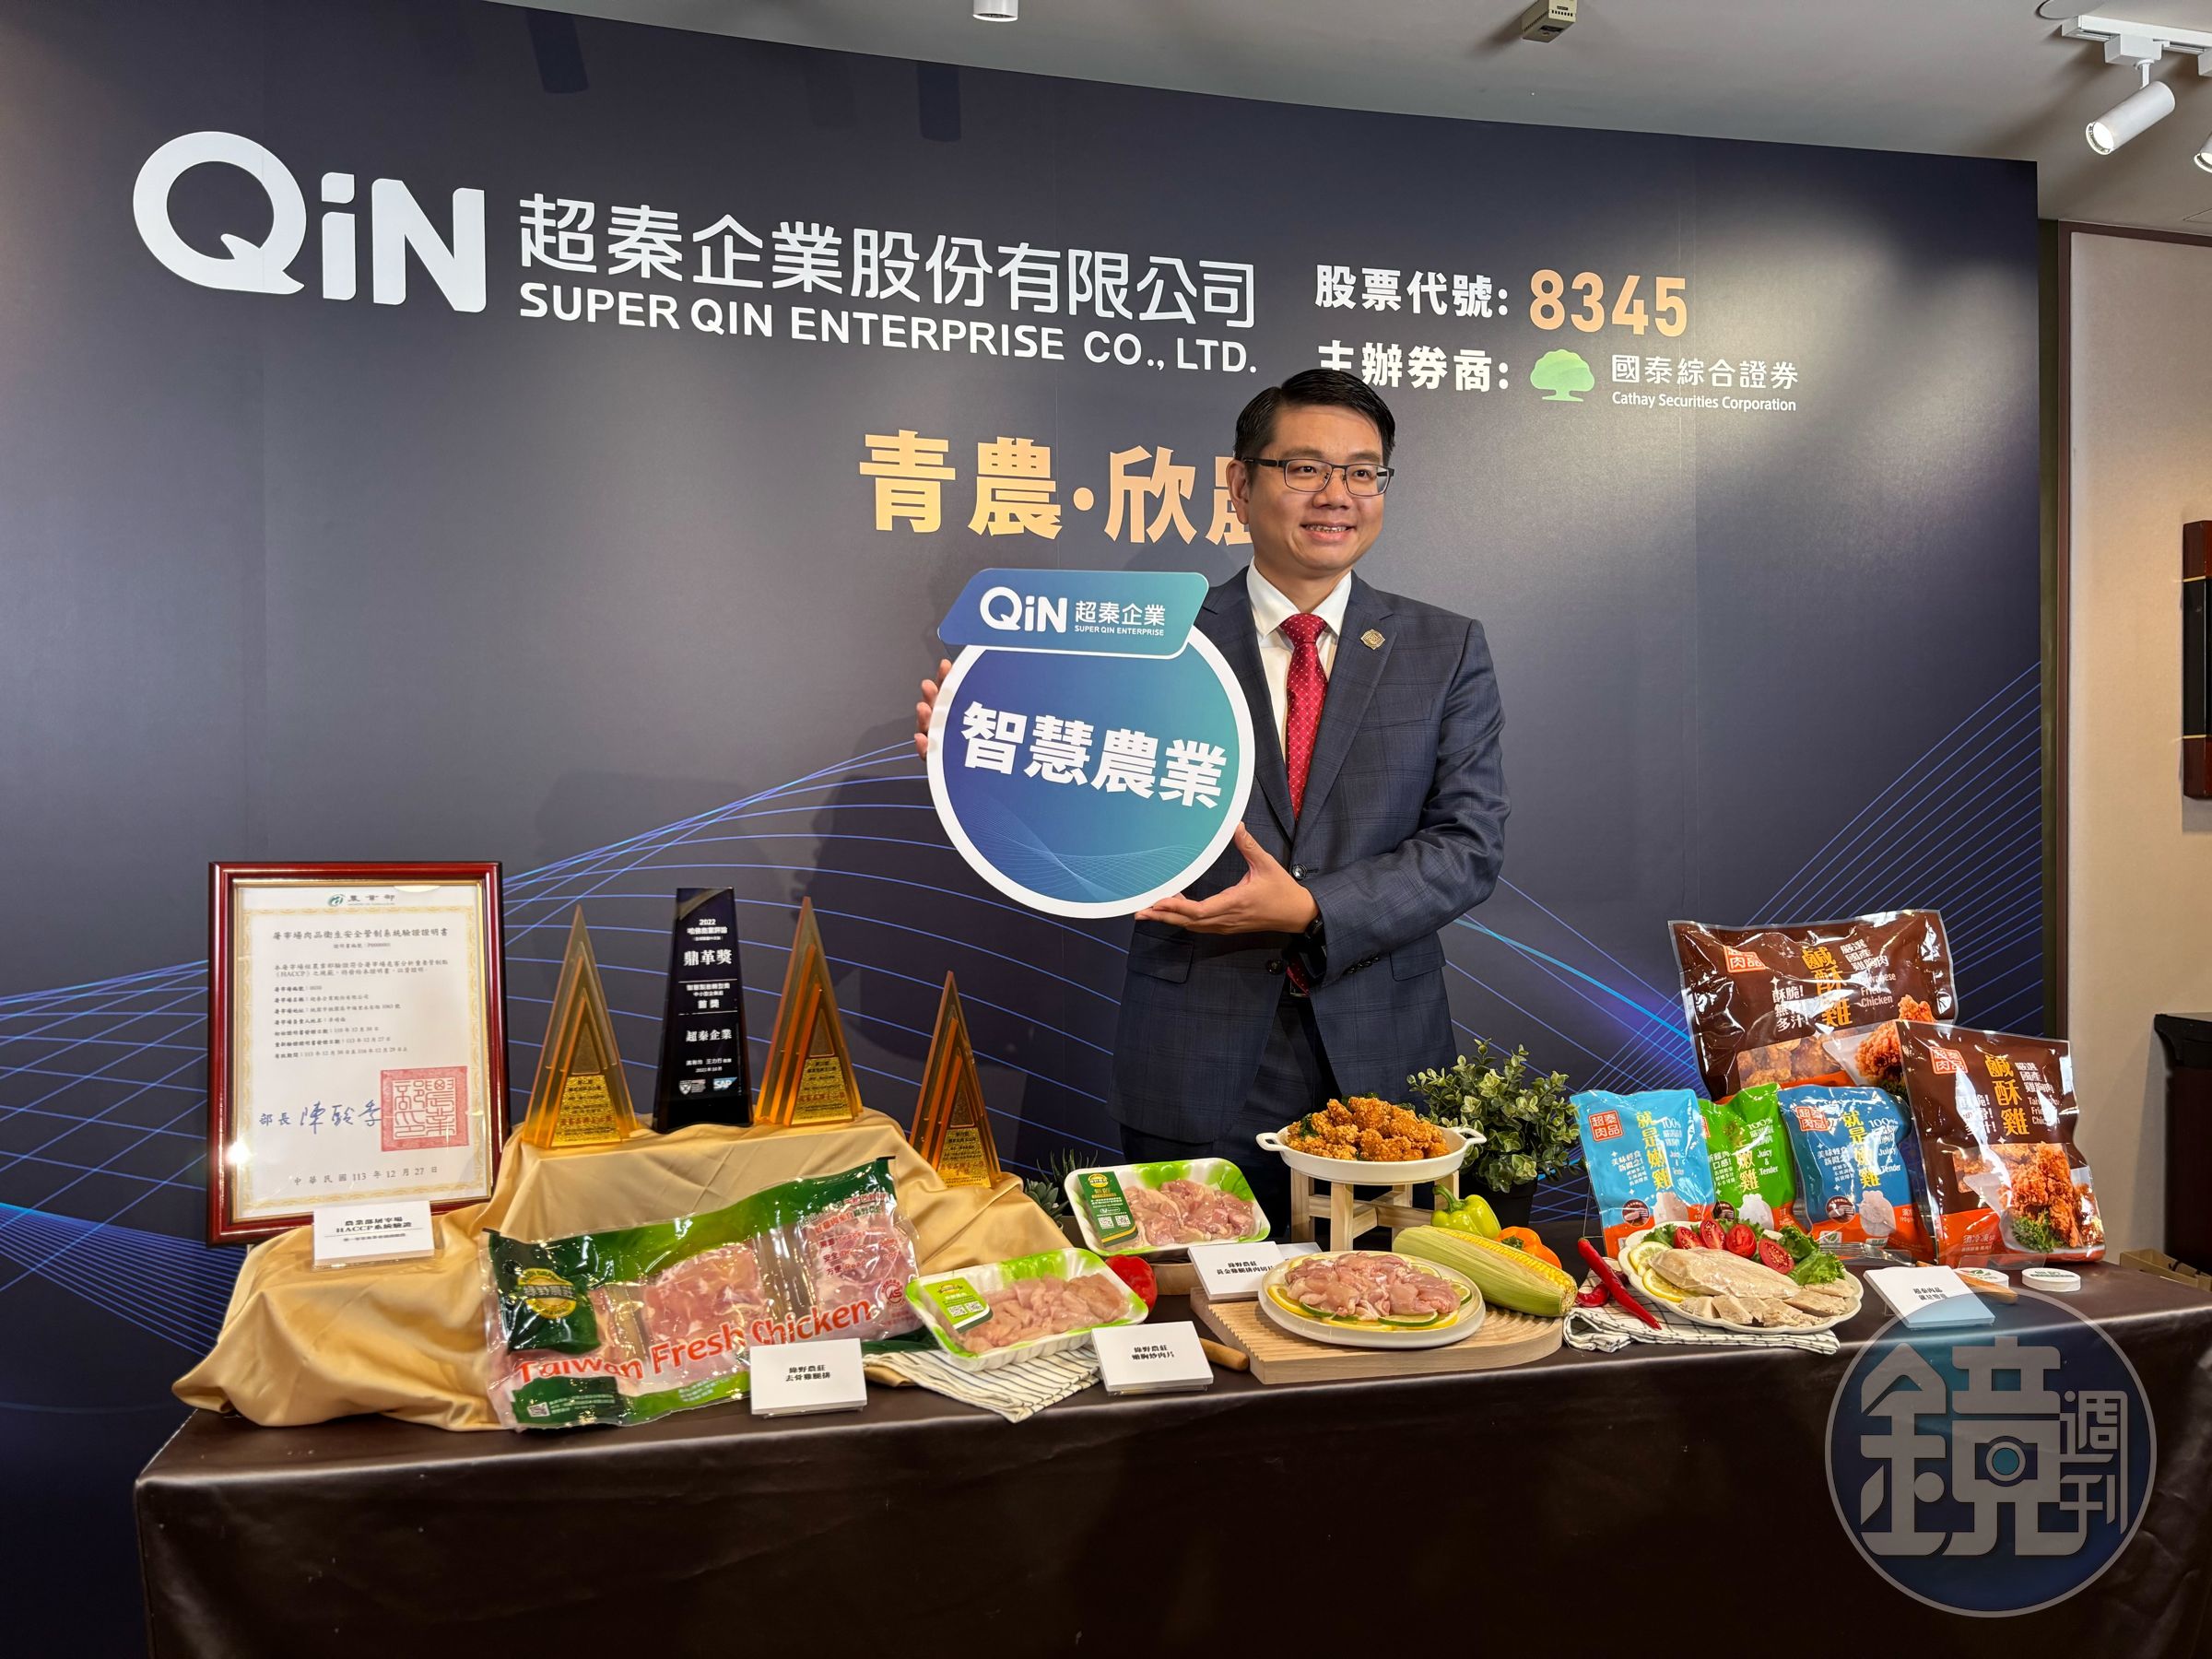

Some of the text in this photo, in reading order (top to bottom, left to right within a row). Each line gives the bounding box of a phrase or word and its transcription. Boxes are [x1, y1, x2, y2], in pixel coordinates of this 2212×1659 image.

[133, 130, 487, 313] QiN
[520, 193, 1255, 329] 超秦企業股份有限公司
[1529, 268, 1688, 338] 8345
[520, 281, 1257, 374] SUPER QIN ENTERPRISE CO., LTD.
[1611, 353, 1799, 391] 國泰綜合證券
[1611, 391, 1797, 413] Cathay Securities Corporation
[979, 585, 1068, 633] QiN
[1075, 600, 1166, 627] 超秦企業
[1074, 624, 1165, 637] SUPER QIN ENTERPRISE
[960, 700, 1227, 809] 智慧農業
[683, 948, 732, 966] 鼎革獎
[1729, 957, 1764, 970] 肉品
[1861, 994, 1893, 1007] Chicken
[685, 1029, 732, 1042] 超秦企業
[1984, 1054, 2030, 1136] 鹹酥雞
[2024, 1082, 2055, 1093] 雞胸肉
[259, 1112, 291, 1126] 部長
[1592, 1112, 1618, 1127] 超秦
[1747, 1117, 1774, 1131] 100%
[1868, 1117, 1899, 1128] 100%
[1594, 1124, 1620, 1139] 肉品
[1757, 1148, 1773, 1159] Juicy
[1764, 1158, 1770, 1166] &
[1879, 1163, 1901, 1174] Tender
[1759, 1165, 1779, 1176] Tender
[514, 1299, 873, 1383] Taiwan Fresh Chicken
[785, 1371, 831, 1382] 去骨雞腿排
